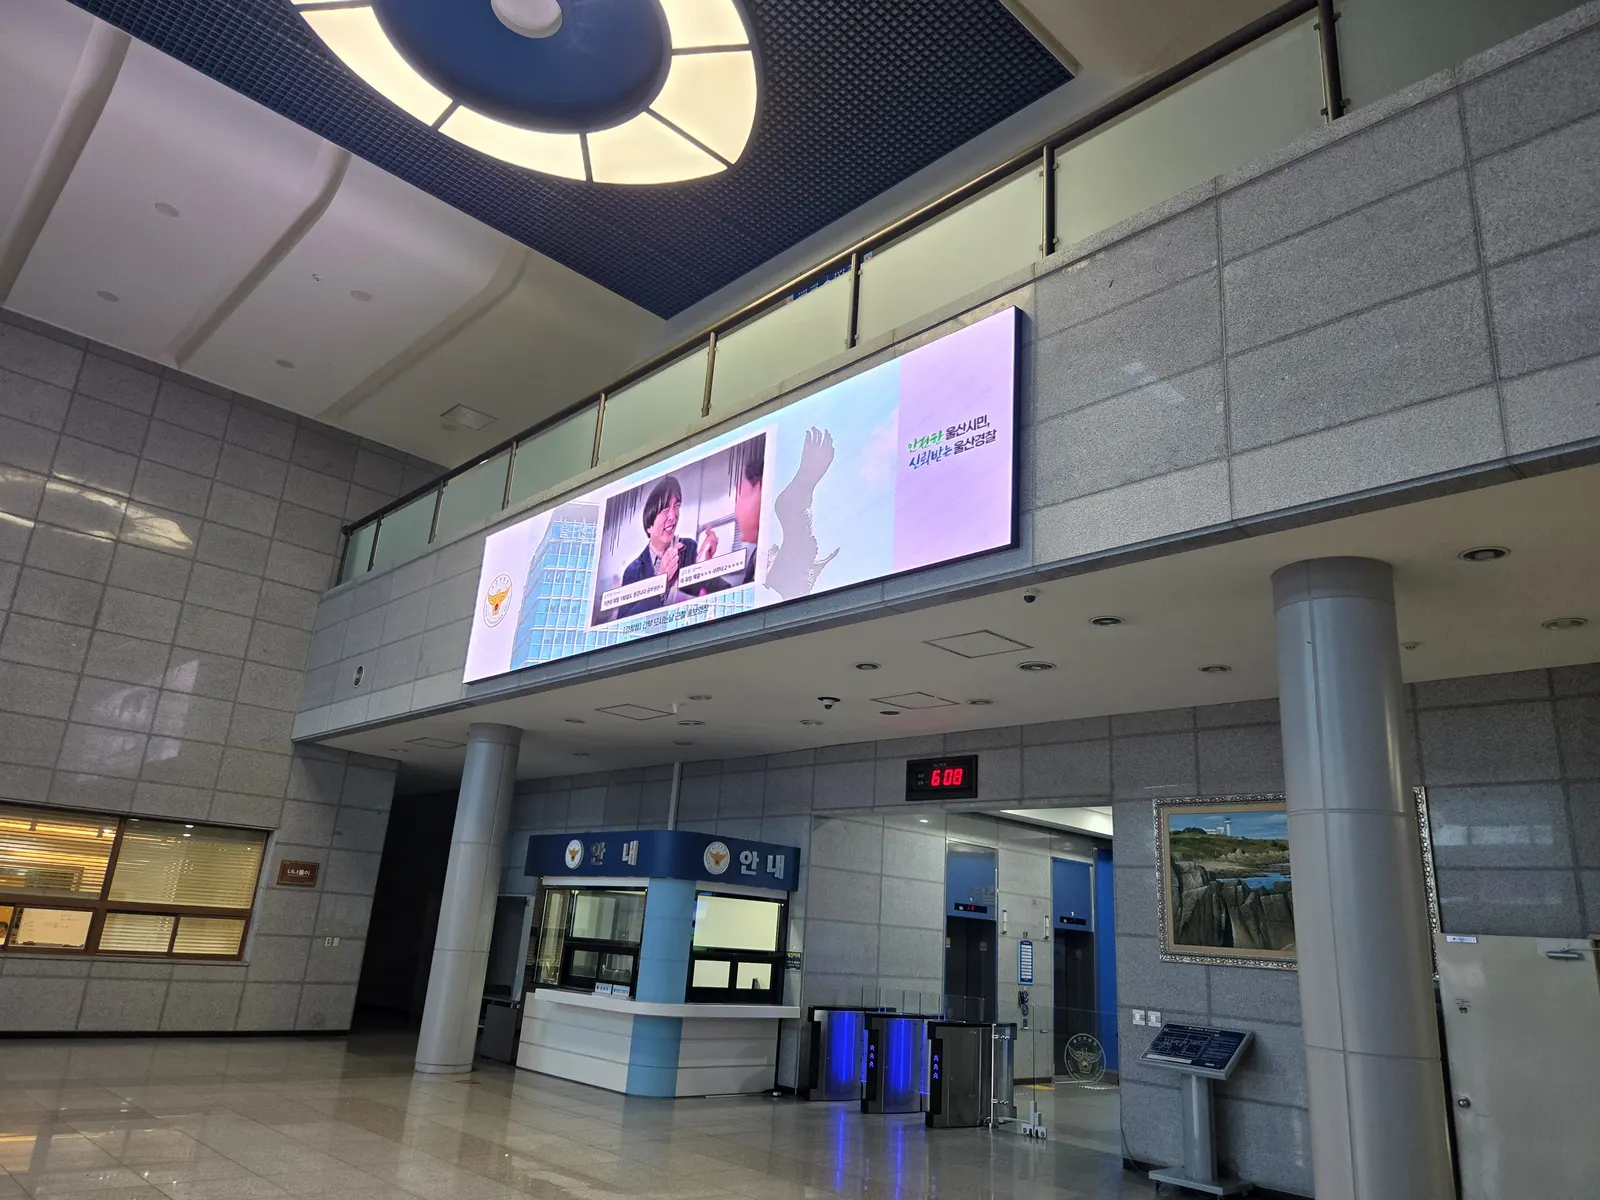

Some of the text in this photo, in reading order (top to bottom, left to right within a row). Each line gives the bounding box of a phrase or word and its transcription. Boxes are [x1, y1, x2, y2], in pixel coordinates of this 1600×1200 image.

[908, 414, 990, 453] 안전한 울산시민,
[909, 429, 997, 469] 신뢰받는 울산경찰
[590, 840, 639, 866] 안내
[739, 850, 785, 880] 안내
